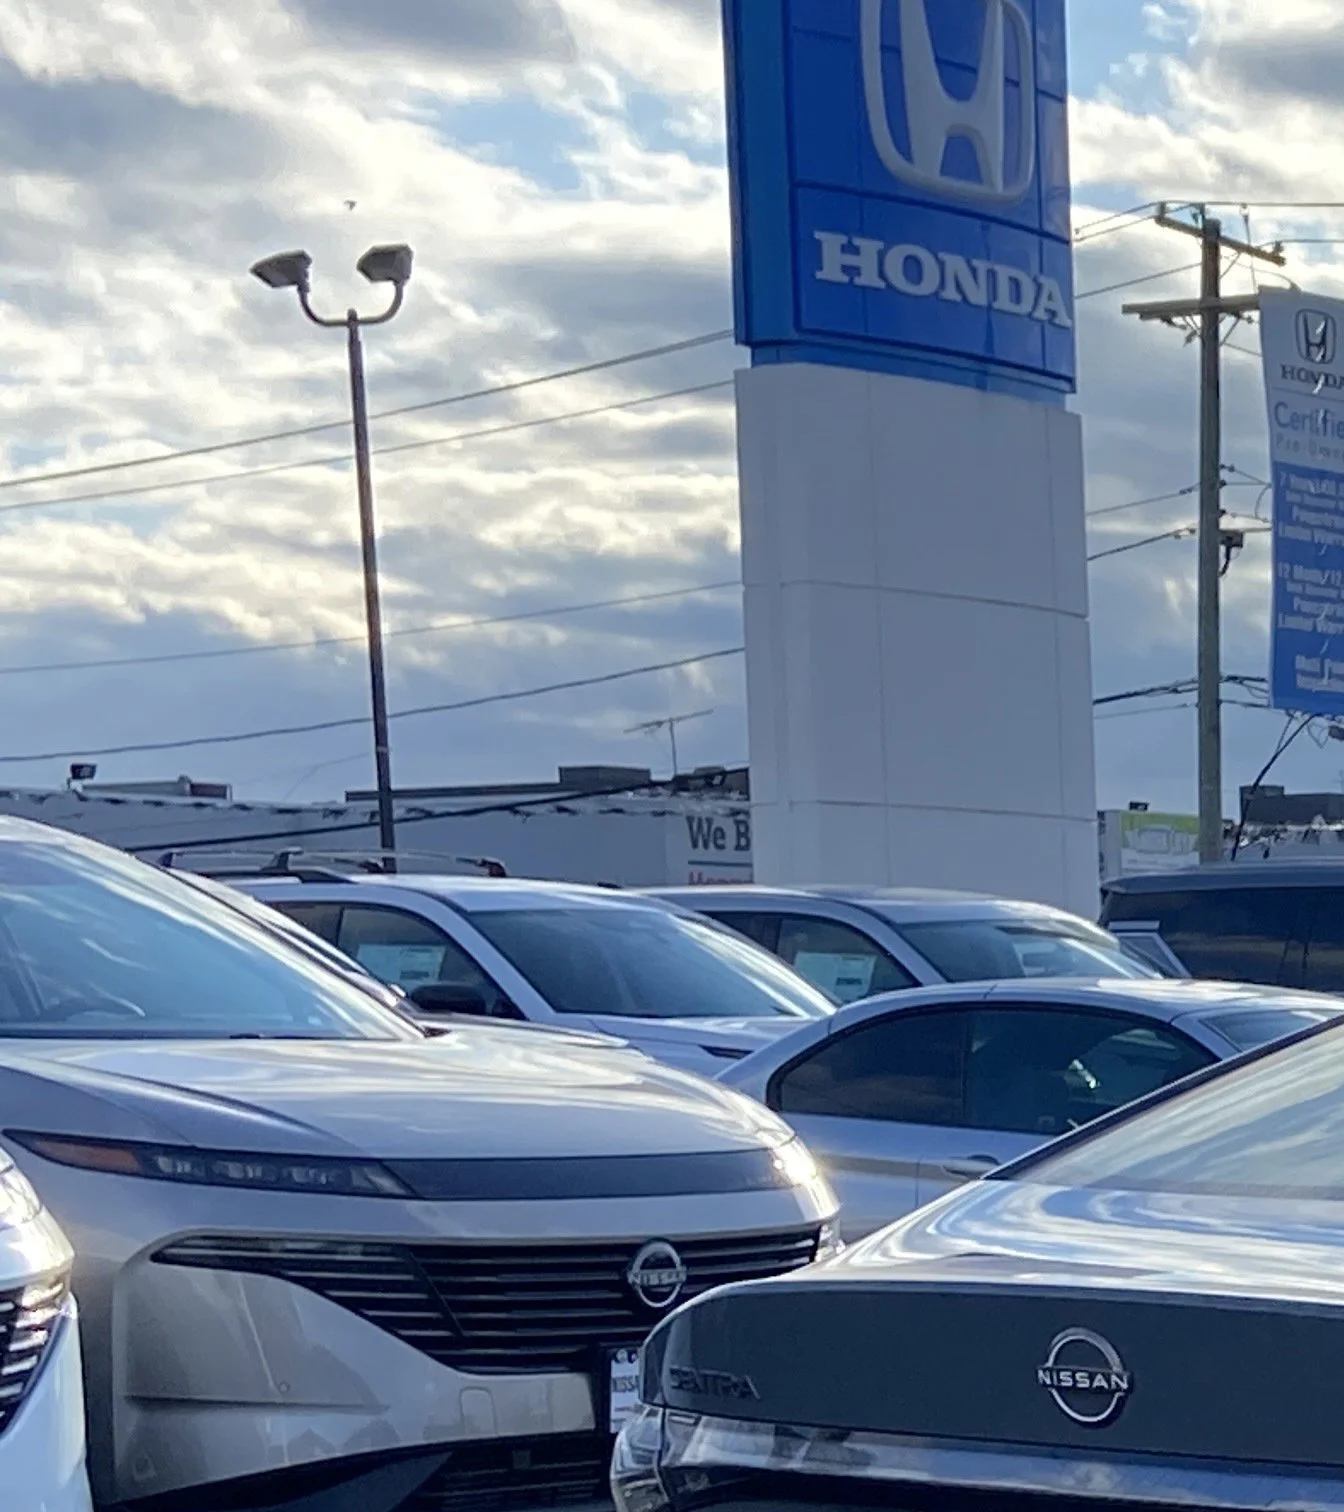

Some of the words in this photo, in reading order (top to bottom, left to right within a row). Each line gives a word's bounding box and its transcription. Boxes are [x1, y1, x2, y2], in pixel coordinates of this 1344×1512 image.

[813, 230, 1072, 329] HONDA
[686, 816, 726, 851] We
[1038, 1369, 1128, 1390] NISSAN
